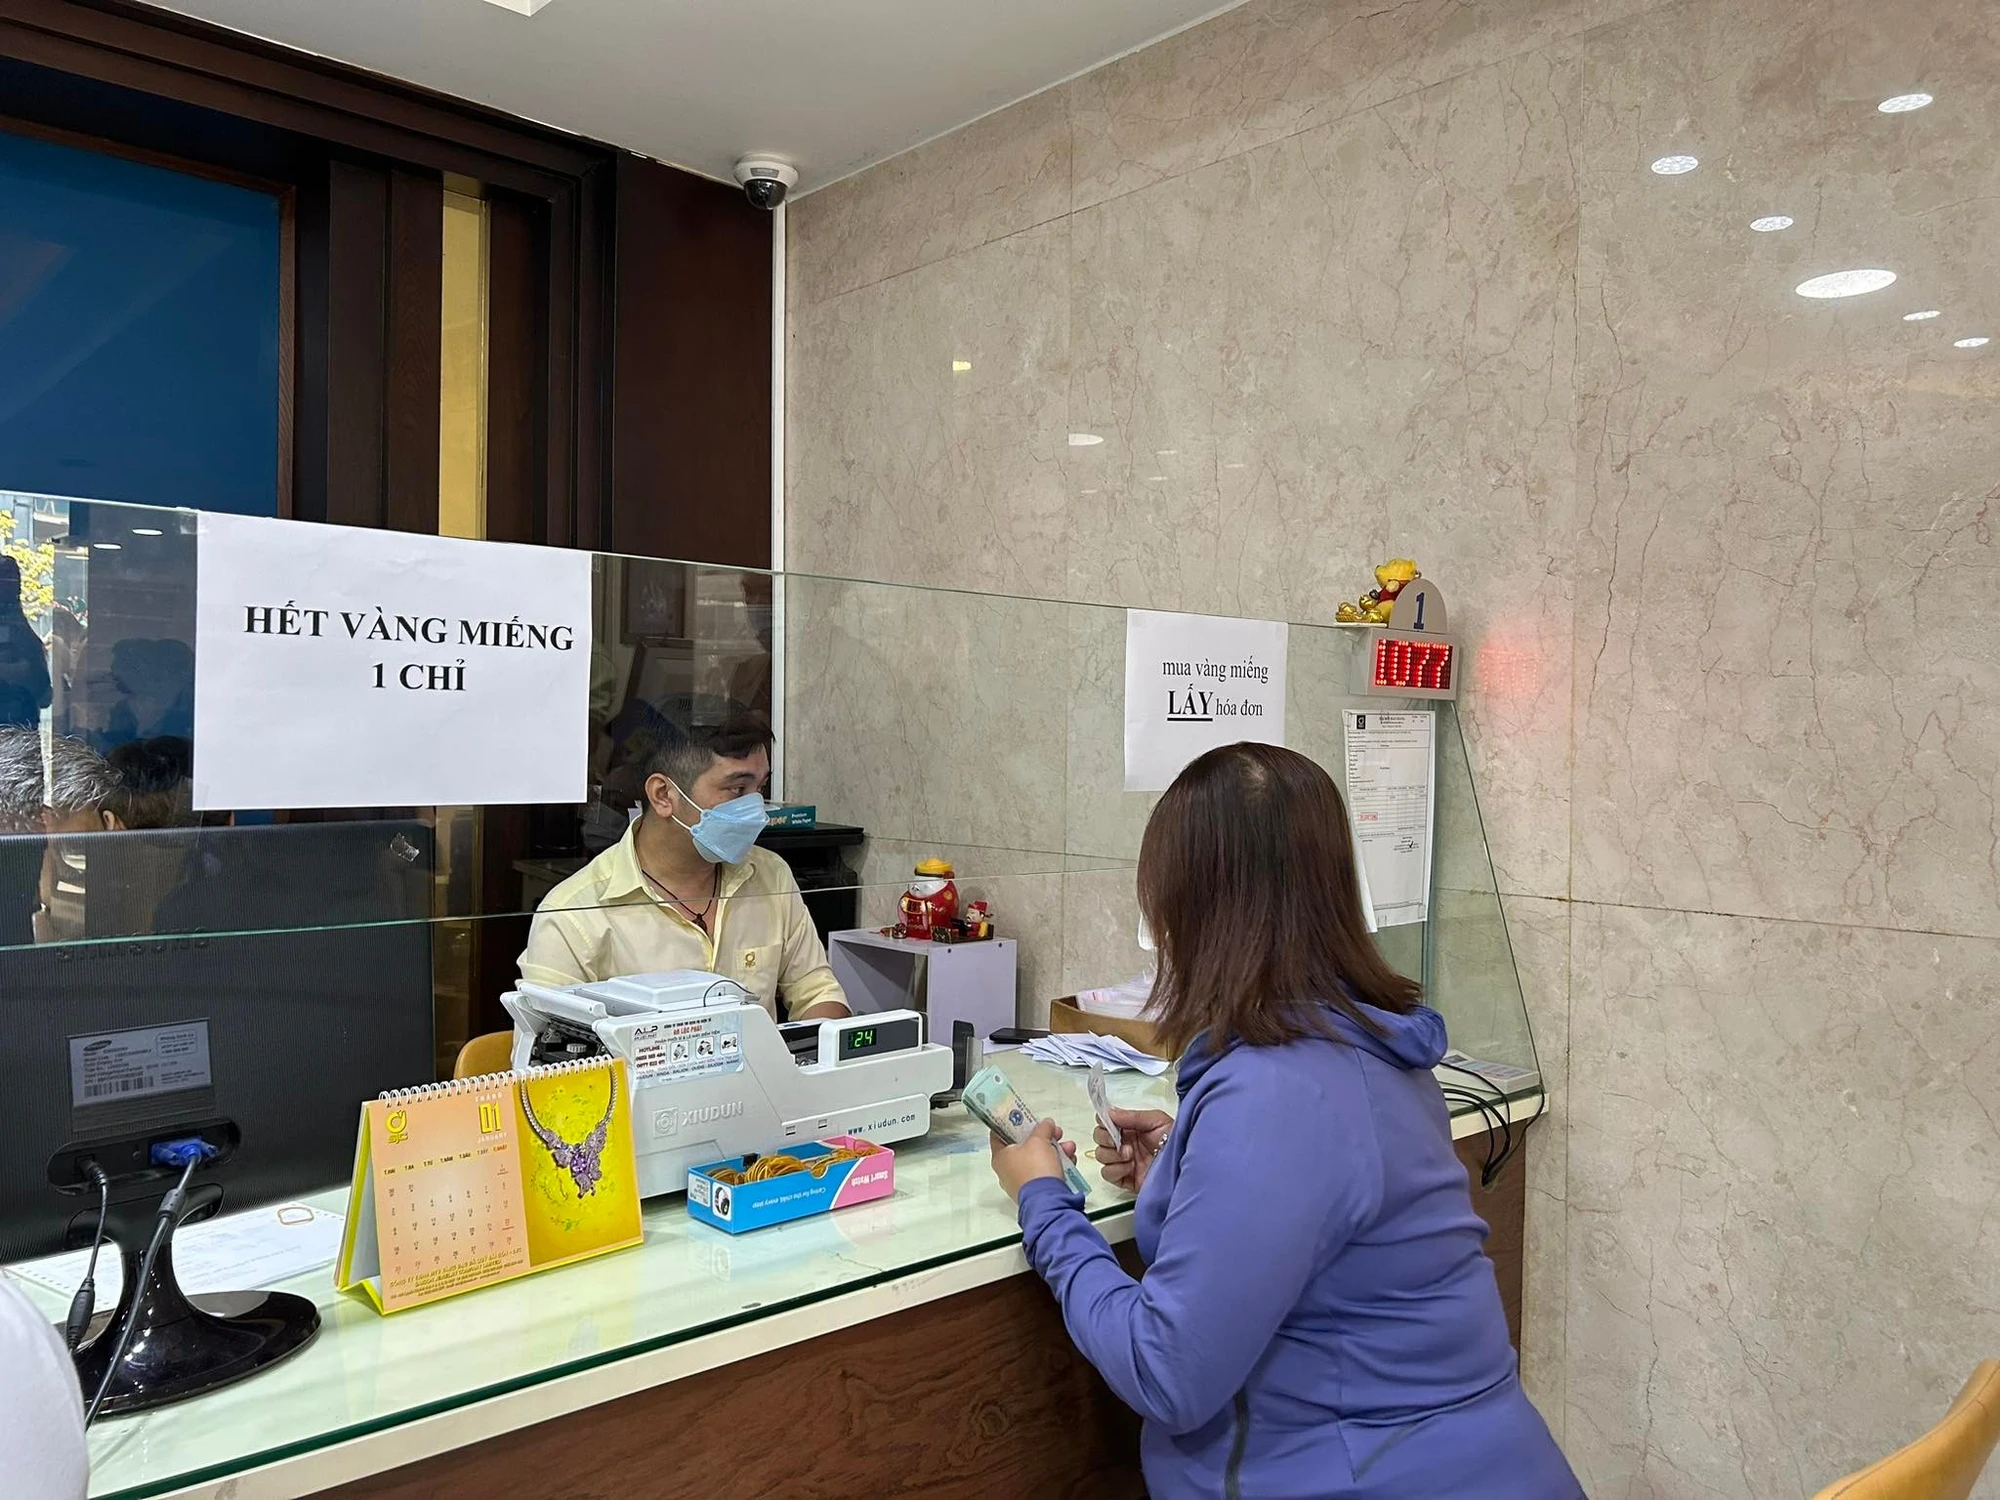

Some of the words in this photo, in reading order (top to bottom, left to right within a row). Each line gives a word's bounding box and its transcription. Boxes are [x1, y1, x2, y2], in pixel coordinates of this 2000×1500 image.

[244, 600, 328, 637] HẾT
[339, 606, 447, 643] VÀNG
[458, 616, 573, 650] MIẾNG
[1413, 592, 1425, 630] 1
[372, 663, 386, 689] 1
[400, 658, 467, 691] CHỈ
[1162, 661, 1191, 676] mua
[1195, 658, 1226, 682] vàng
[1230, 656, 1269, 684] miếng
[1376, 638, 1450, 688] 1077
[1167, 683, 1213, 715] LẤY
[1215, 698, 1237, 716] hóa
[1241, 699, 1263, 716] đơn
[854, 1030, 873, 1047] 24
[682, 1101, 743, 1126] XIUDUN
[847, 1113, 916, 1135] www.xiudun.com
